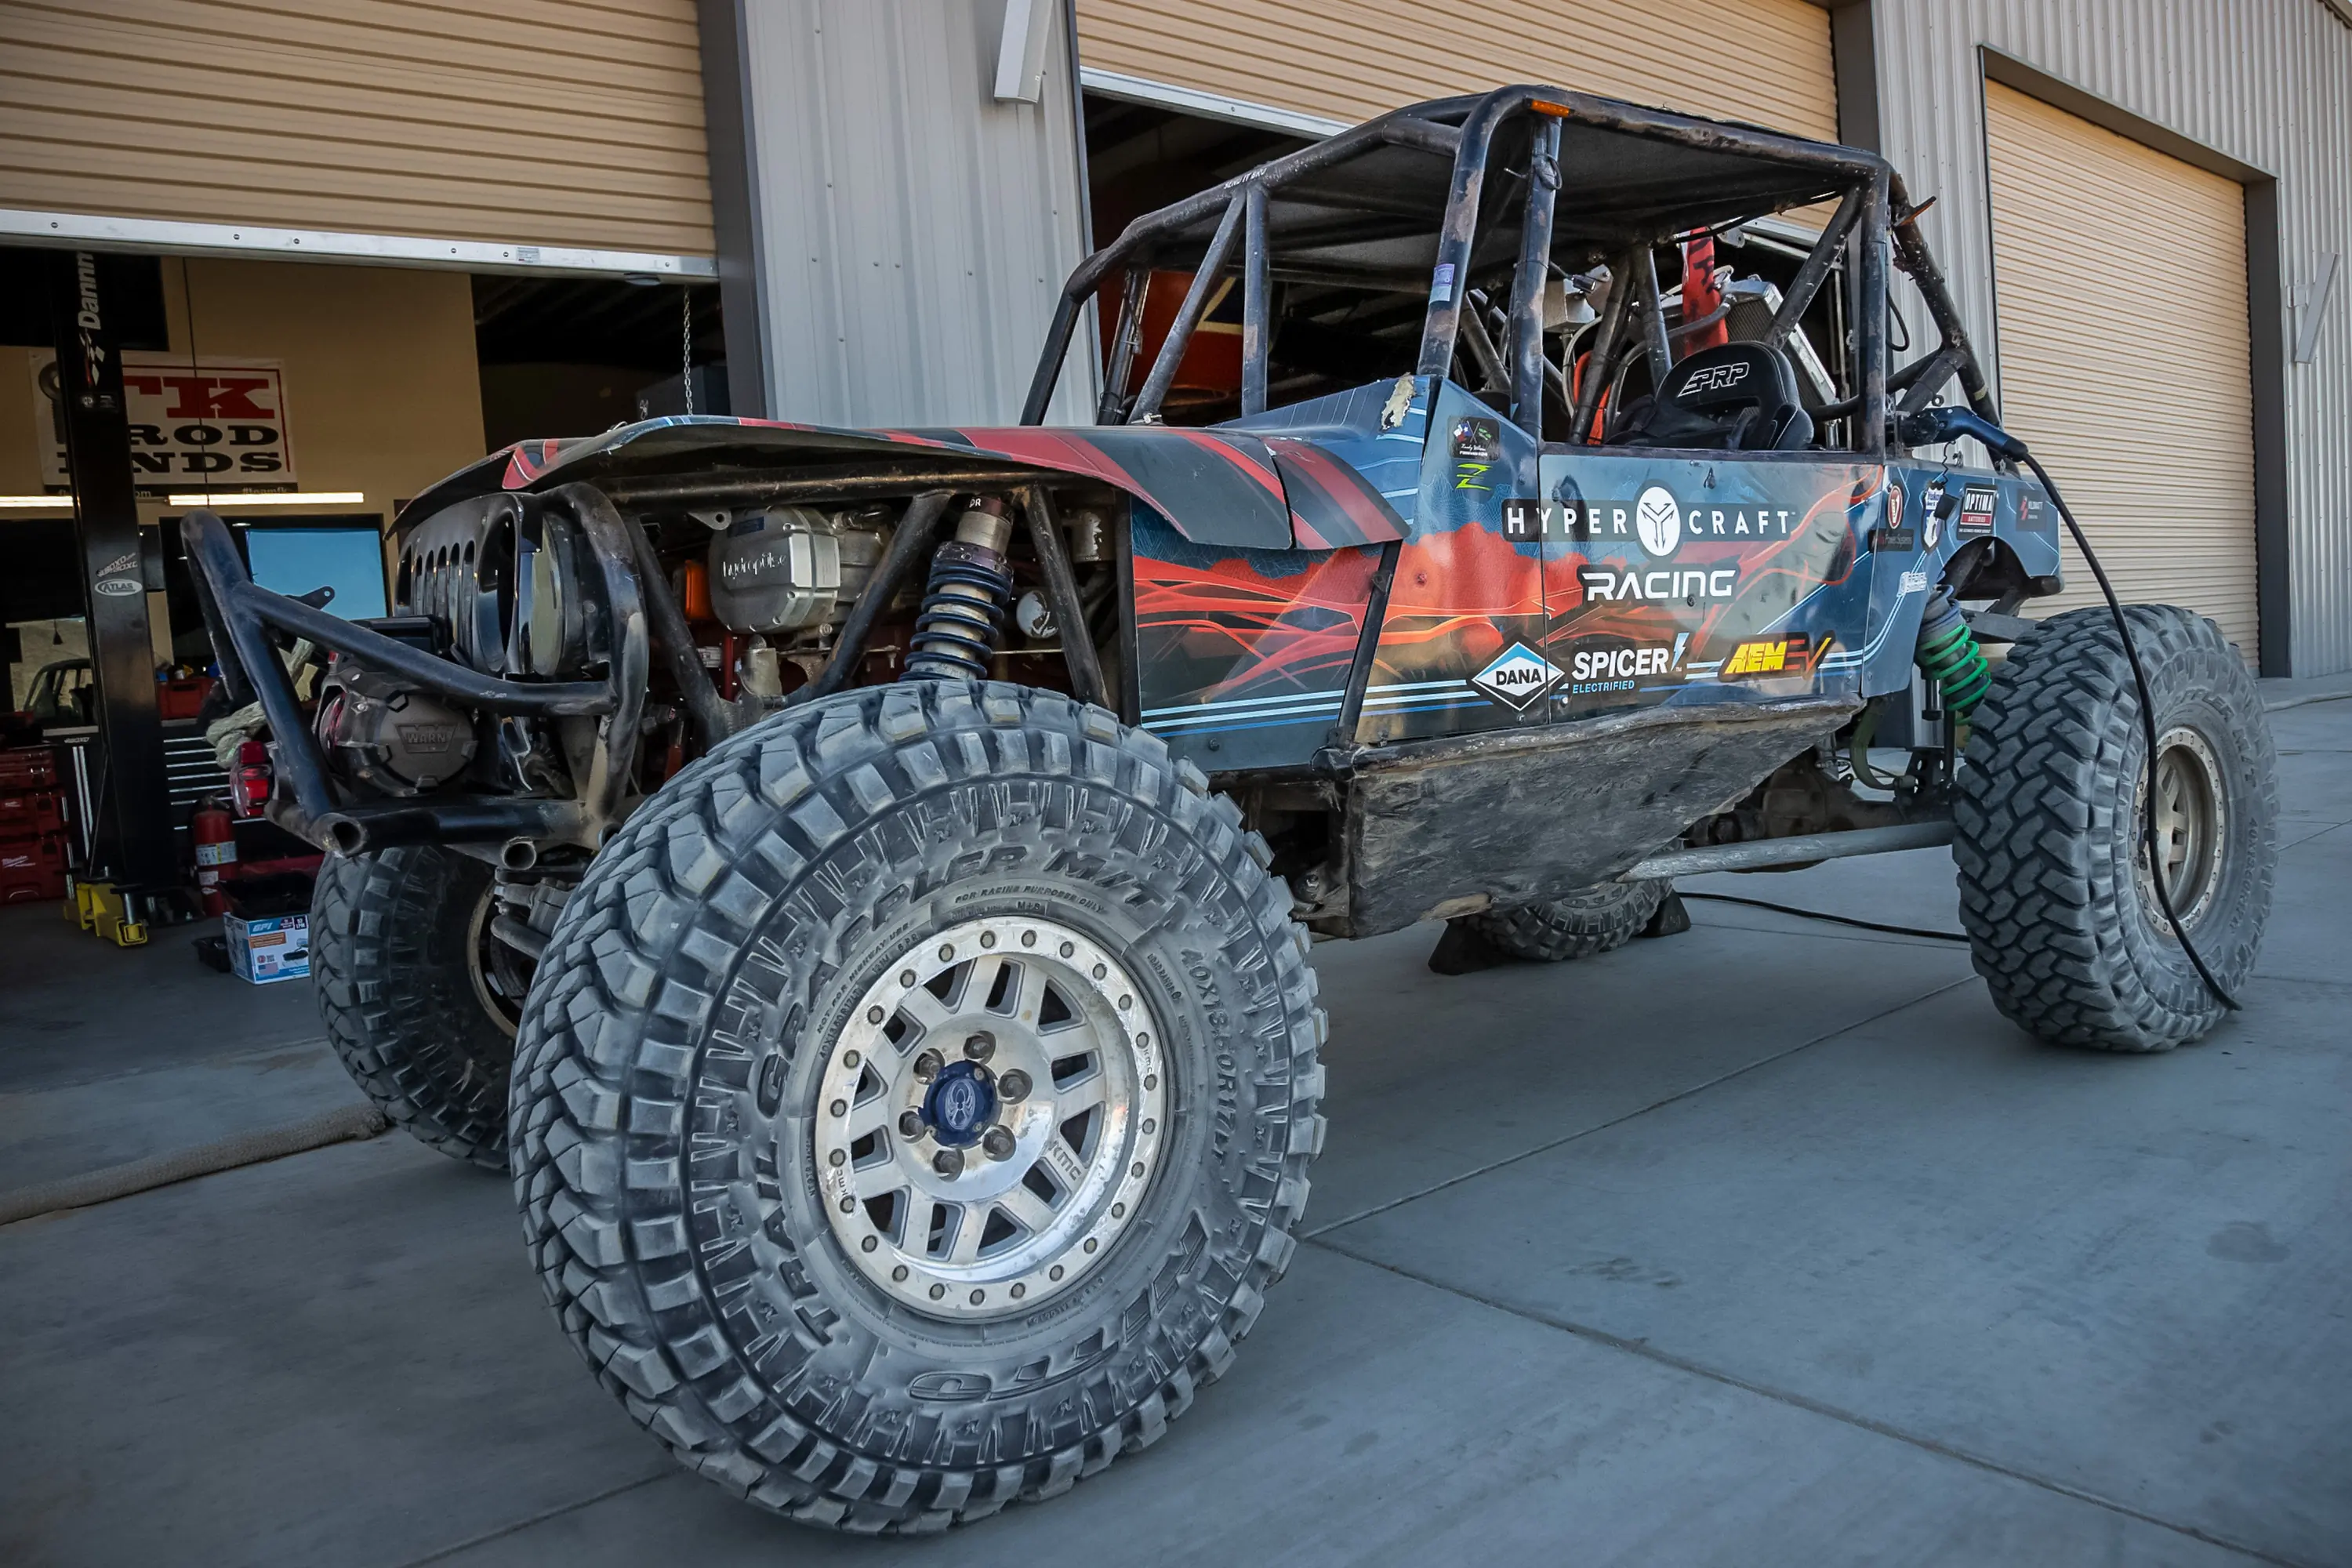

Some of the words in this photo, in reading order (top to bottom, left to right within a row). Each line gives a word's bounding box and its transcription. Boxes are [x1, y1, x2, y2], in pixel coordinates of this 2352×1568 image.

[1677, 362, 1749, 397] PRP
[1965, 493, 1993, 511] OPTIMA
[1507, 508, 1627, 534] HYPER
[1688, 510, 1791, 535] CRAFT
[1582, 569, 1736, 601] RACING
[1571, 648, 1669, 681] SPICER
[1495, 668, 1542, 685] DANA
[1573, 680, 1635, 694] ELECTRIFIED
[407, 733, 447, 744] WARN
